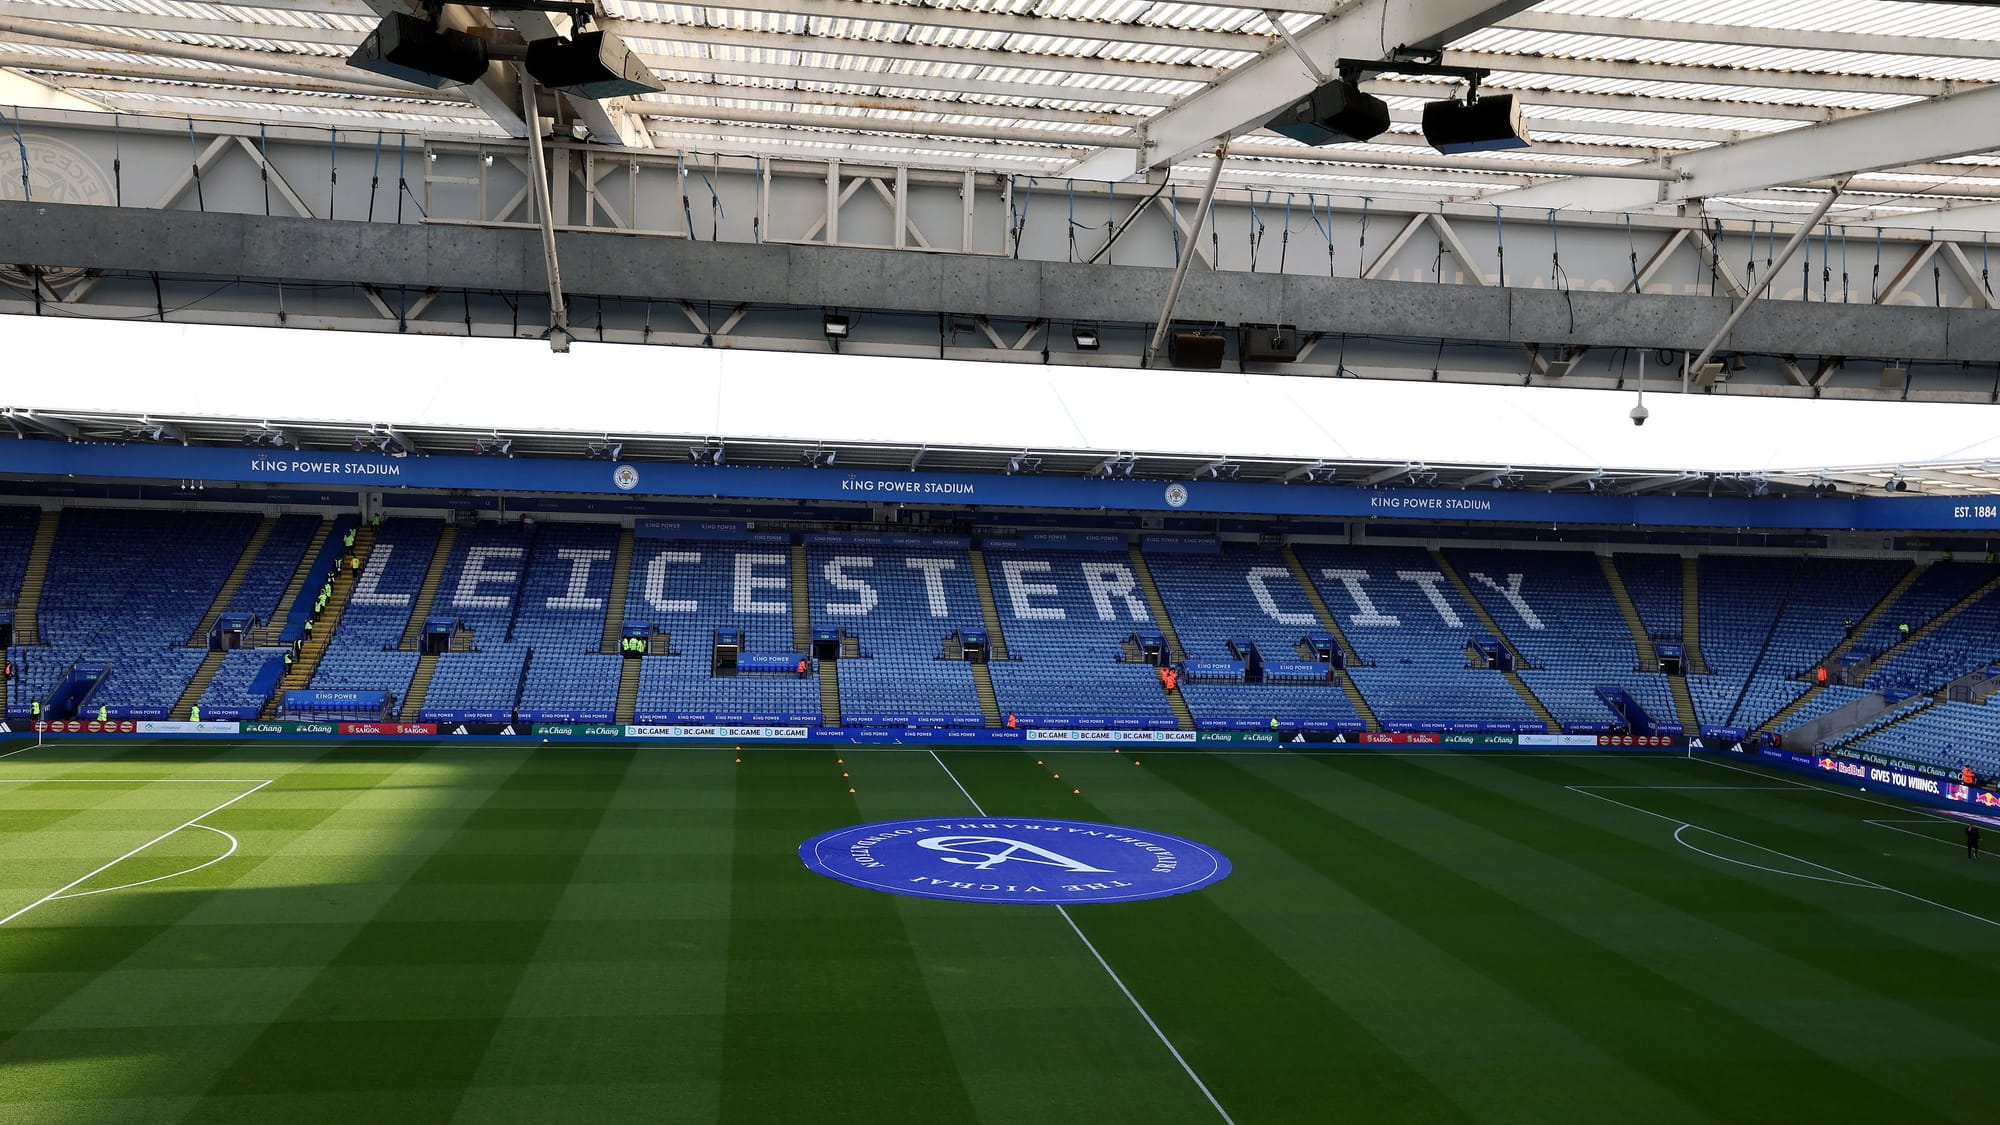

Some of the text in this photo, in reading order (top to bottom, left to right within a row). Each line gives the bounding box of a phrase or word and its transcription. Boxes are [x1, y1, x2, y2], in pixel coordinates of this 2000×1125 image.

[251, 460, 400, 475] KING POWER STADIUM
[842, 480, 974, 494] KING POWER STADIUM
[1371, 497, 1491, 510] KING POWER STADIUM
[1954, 505, 1997, 518] EST. 1884
[350, 544, 1545, 631] LEICESTER CITY
[257, 724, 283, 733] Chang
[307, 724, 332, 734] Chang
[355, 726, 380, 734] SAIGON
[404, 726, 428, 734] SAIGON
[549, 726, 572, 736] Chang
[596, 727, 619, 736] Chang
[637, 728, 670, 736] BC.GAME
[683, 728, 715, 736] BC.GAME
[774, 729, 806, 737] BC.GAME
[1210, 733, 1232, 742] Chang
[1251, 733, 1273, 743] Chang
[1453, 736, 1474, 745] Chang
[1493, 736, 1514, 745] Chang
[1870, 768, 1890, 783] GIVES
[1891, 773, 1907, 787] YOU
[849, 826, 934, 870] FOUNDATION
[909, 875, 1133, 893] THE VICHAI
